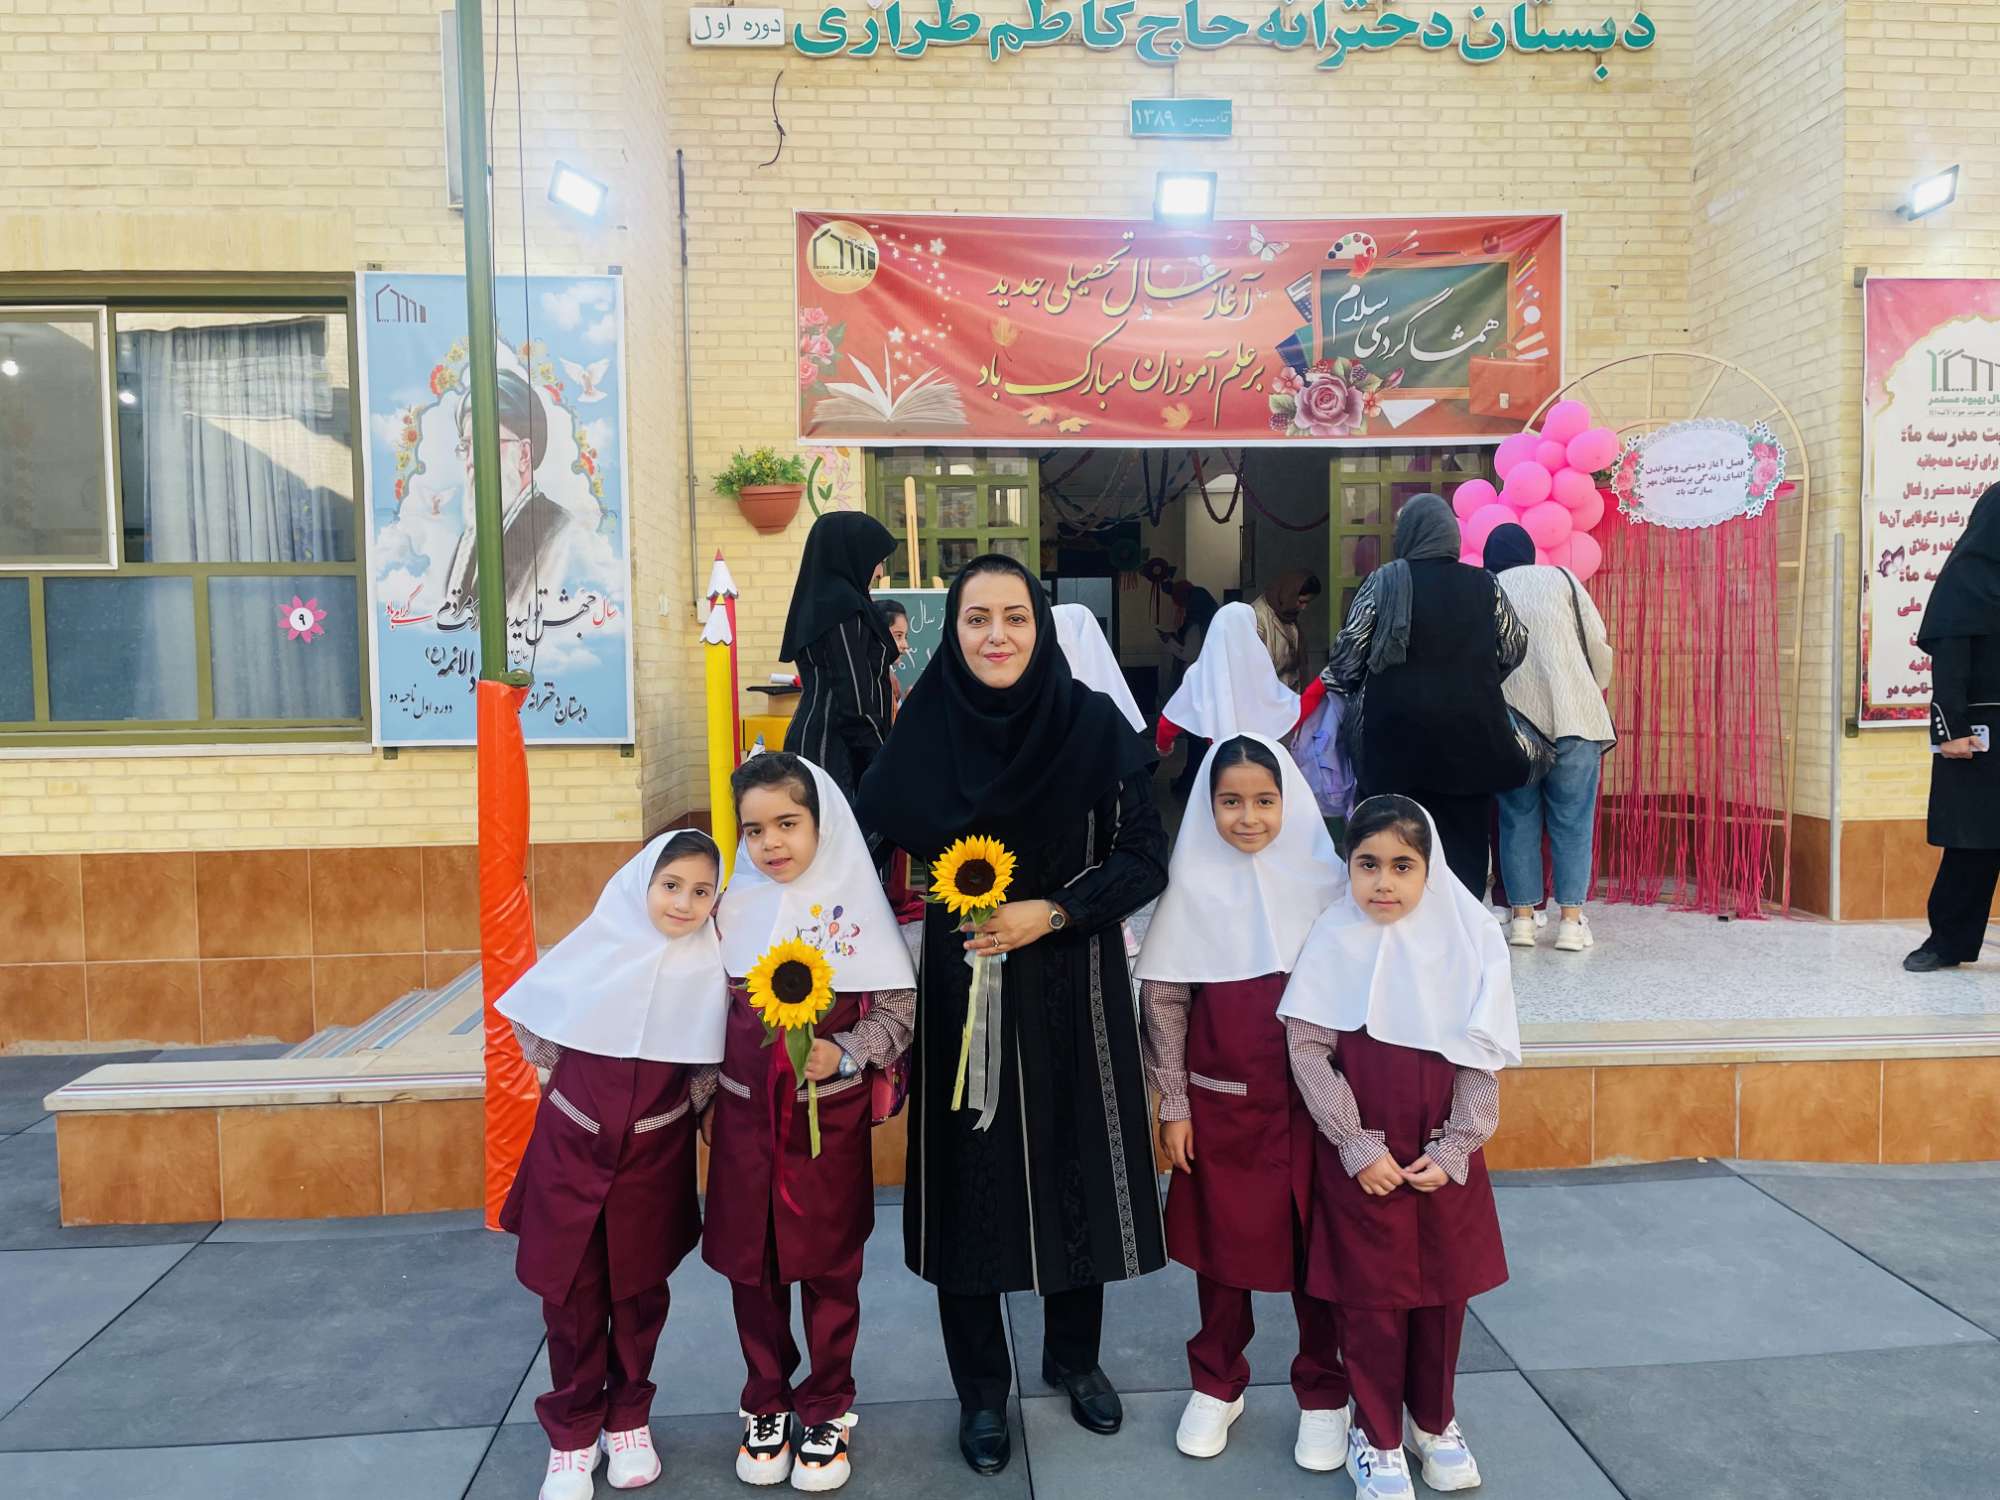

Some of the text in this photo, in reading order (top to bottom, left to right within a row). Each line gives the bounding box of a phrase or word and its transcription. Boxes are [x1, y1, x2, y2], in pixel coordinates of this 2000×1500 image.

[695, 13, 780, 40] دوره اول
[988, 0, 1136, 62] کاظم
[1136, 0, 1250, 65] حاج
[1257, 0, 1454, 70] دخترانه
[1458, 0, 1656, 81] دبستان
[1136, 109, 1175, 127] ۱۳۸۹
[987, 231, 1264, 320] آغاز سال تحصیلی جدید
[1332, 284, 1390, 345] سلام
[976, 352, 1001, 401] باد
[1004, 320, 1128, 410] مبارک
[1926, 428, 1978, 447] مدرسه
[1955, 453, 1979, 471] تربیت
[1980, 453, 1999, 471] برای
[1923, 487, 1929, 499] و
[1947, 510, 1965, 527] رشد
[1909, 538, 1930, 555] خلاق
[299, 614, 306, 626] ۹
[910, 600, 936, 633] سال
[413, 696, 432, 719] اول
[434, 704, 453, 714] دوره
[528, 682, 561, 712] دخترانه
[554, 696, 587, 724] دبستان
